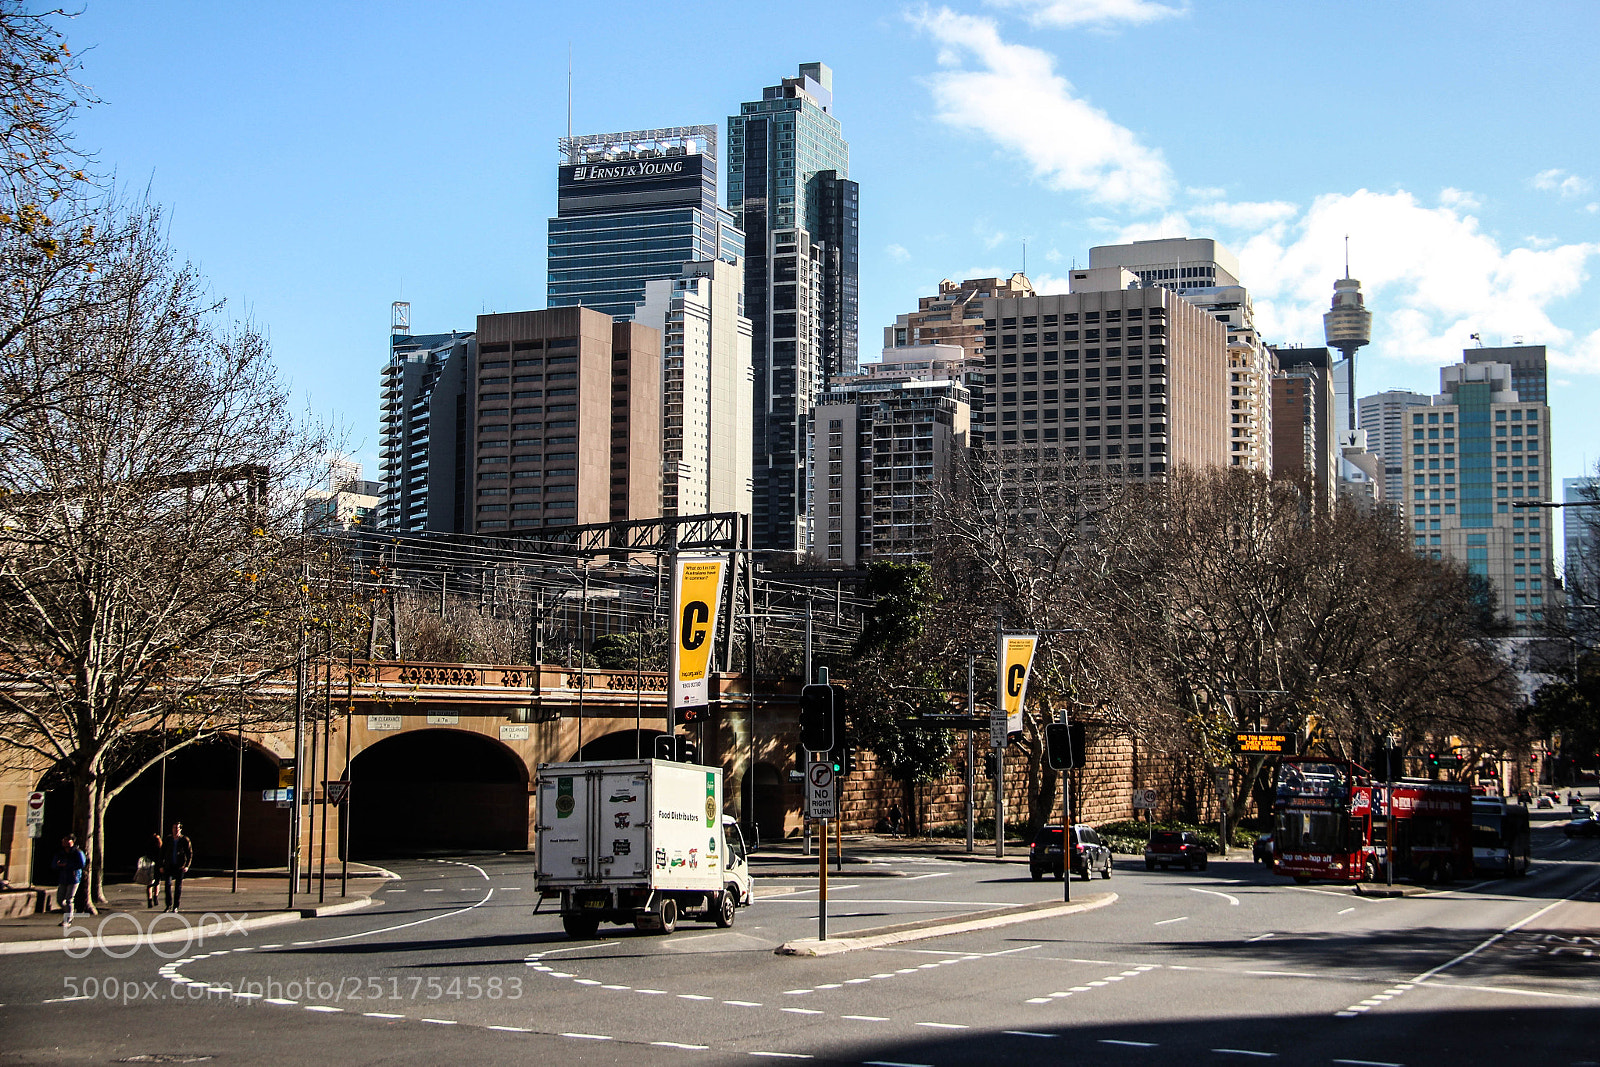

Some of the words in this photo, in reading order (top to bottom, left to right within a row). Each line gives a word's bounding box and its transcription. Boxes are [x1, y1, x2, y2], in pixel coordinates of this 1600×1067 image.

[589, 165, 627, 179] ERNST
[627, 165, 637, 176] &
[638, 161, 683, 175] YOUNG
[682, 601, 708, 650] C
[1007, 663, 1026, 697] C
[814, 790, 828, 798] NO
[658, 810, 671, 819] Food
[671, 811, 699, 822] Distributors
[1309, 854, 1321, 863] hop
[1322, 854, 1332, 862] off
